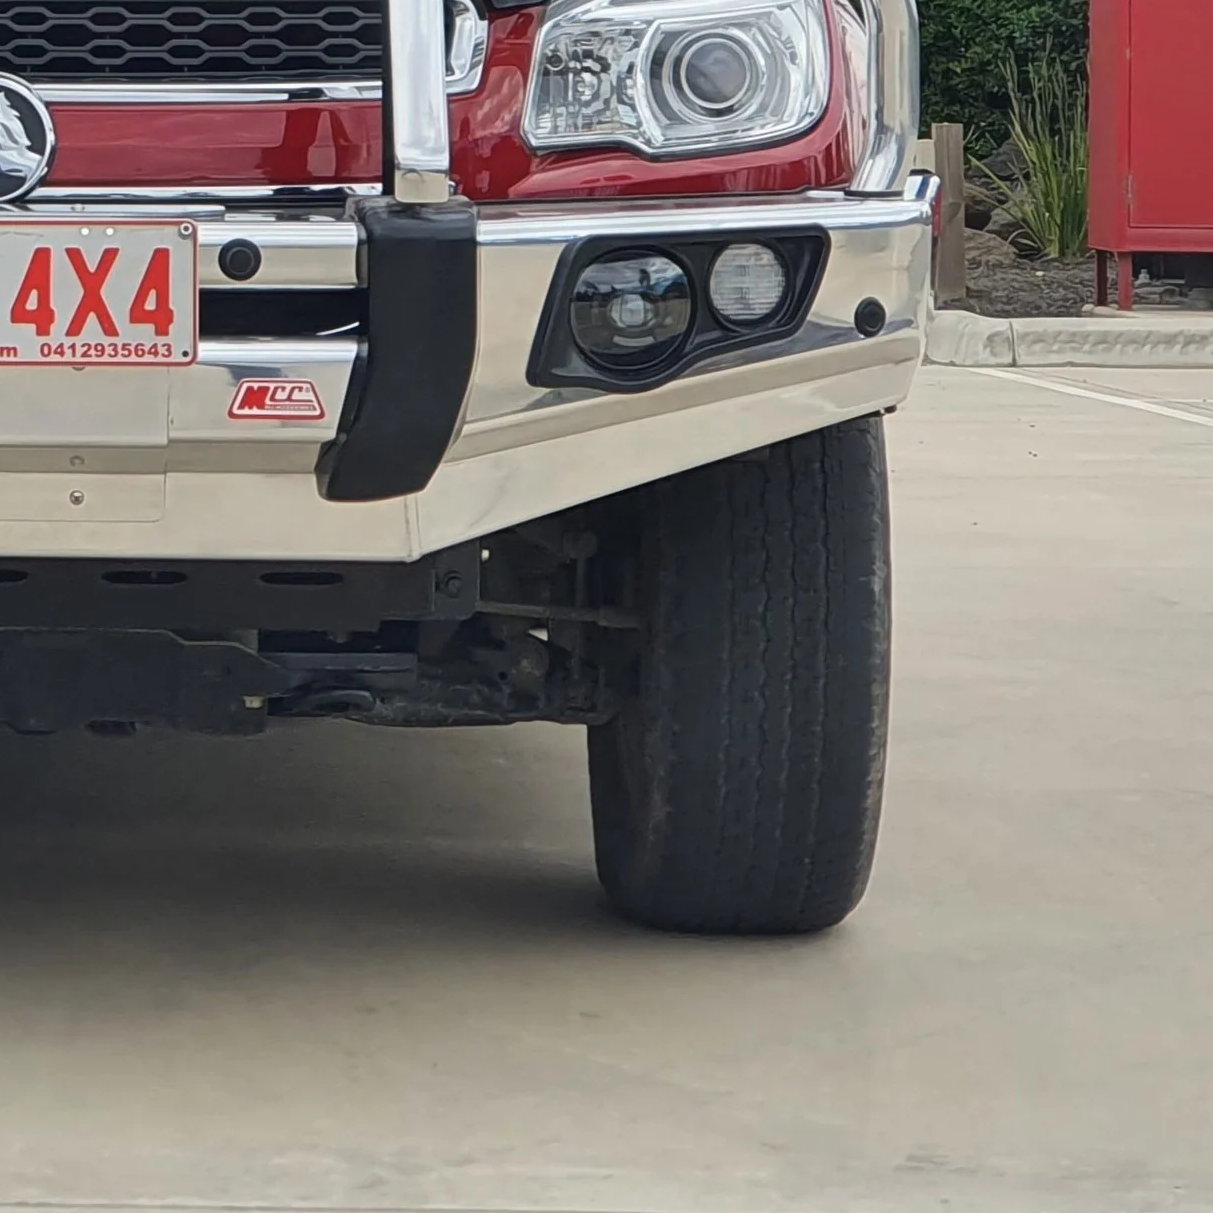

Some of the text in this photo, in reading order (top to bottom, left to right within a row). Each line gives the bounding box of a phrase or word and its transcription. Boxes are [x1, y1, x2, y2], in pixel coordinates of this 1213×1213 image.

[10, 247, 175, 337] 4X4
[39, 342, 174, 359] 0412935643
[237, 385, 314, 411] MCC
